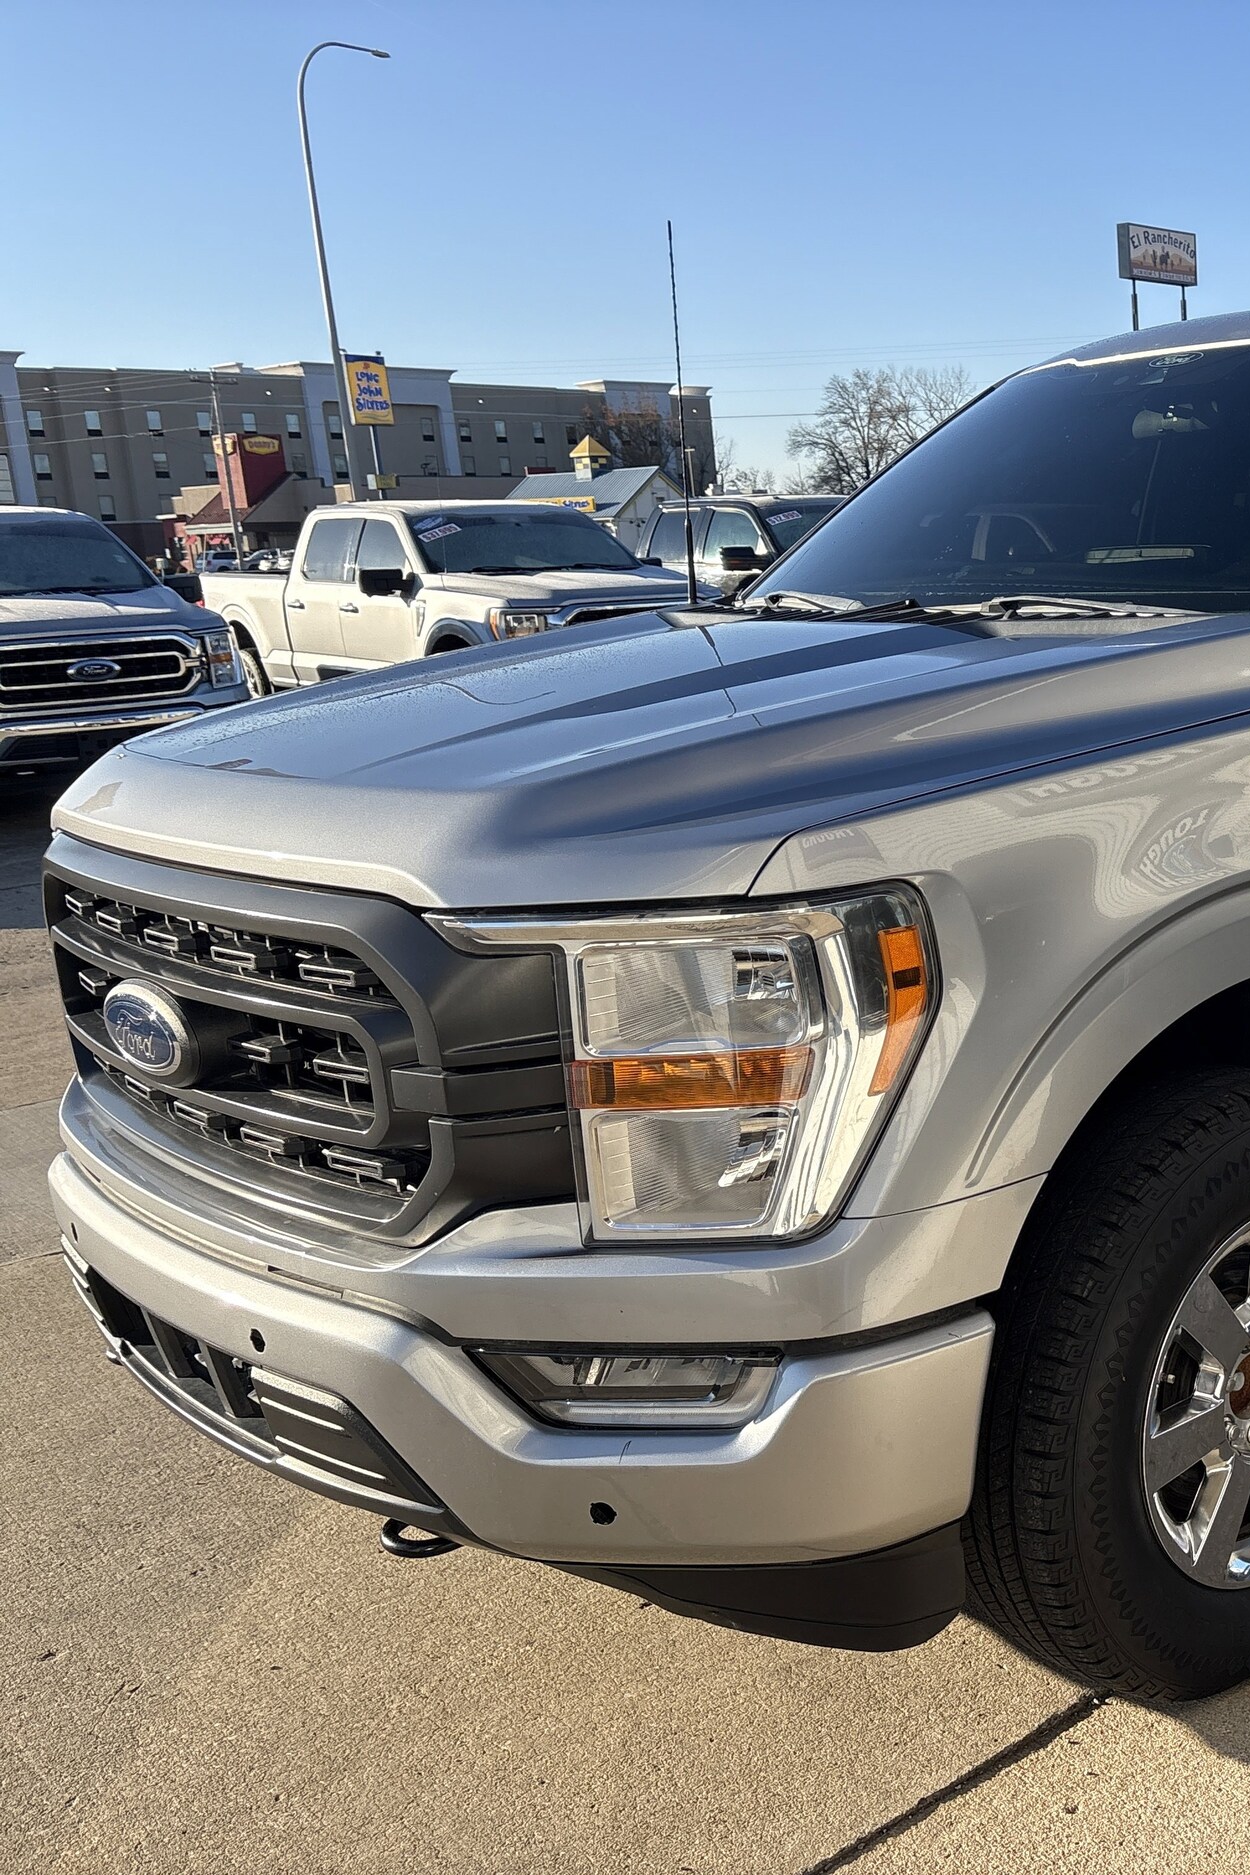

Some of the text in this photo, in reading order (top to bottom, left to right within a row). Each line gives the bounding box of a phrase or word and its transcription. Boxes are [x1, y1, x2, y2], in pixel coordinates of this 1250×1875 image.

[1130, 230, 1196, 259] El Rancherito
[115, 1008, 156, 1061] Ford
